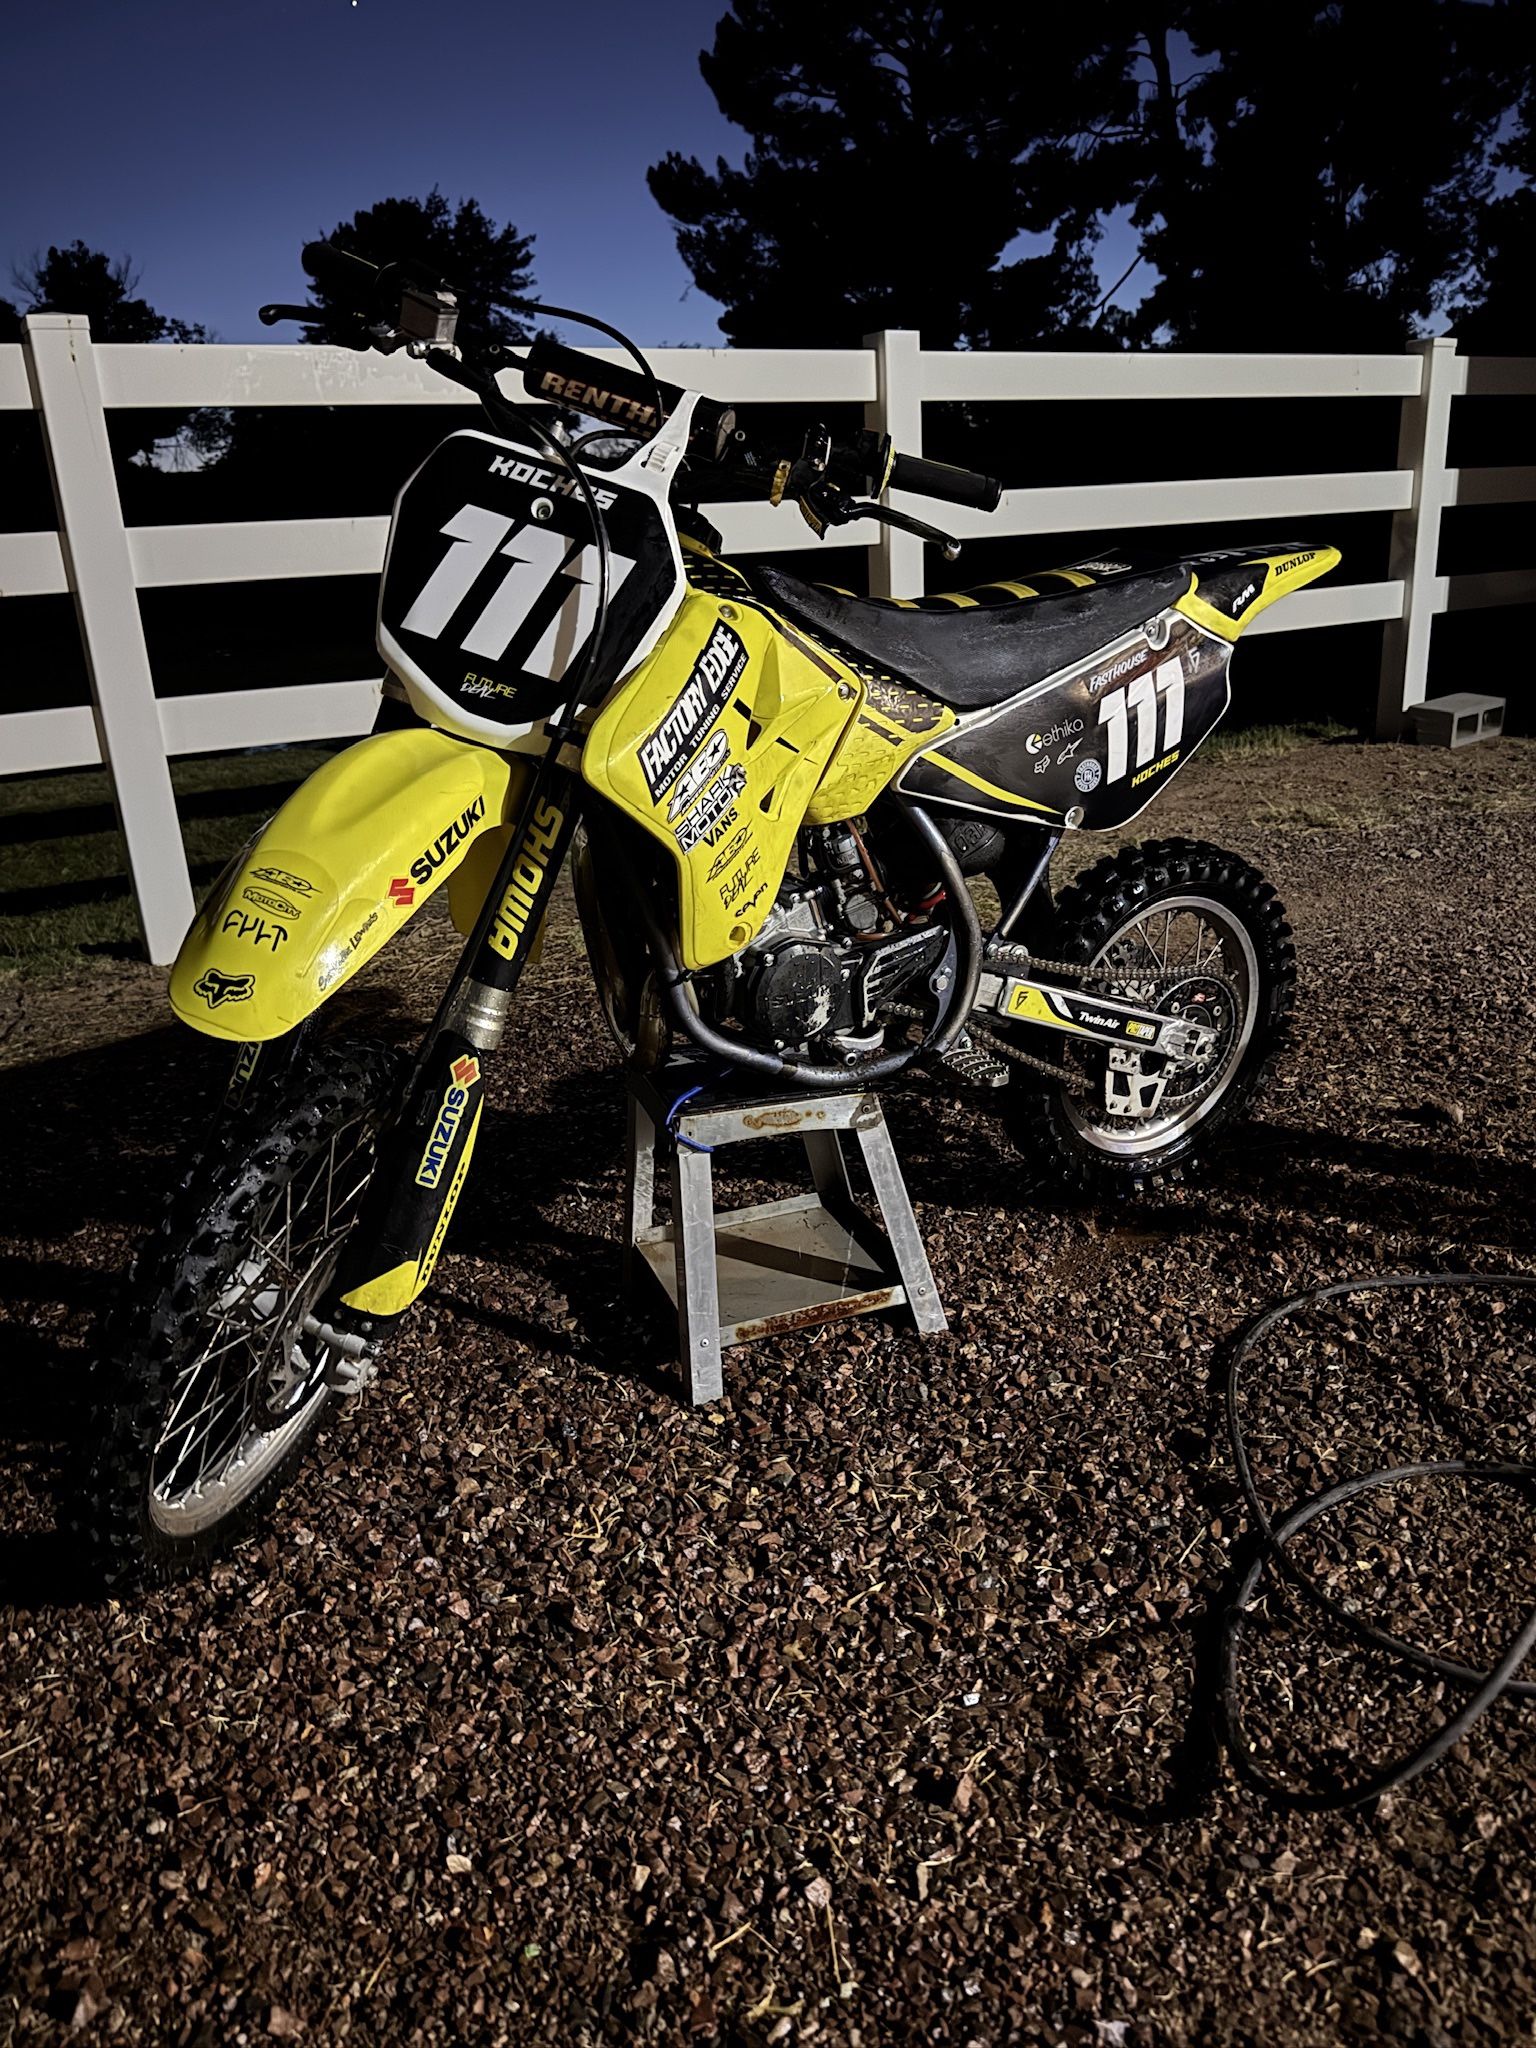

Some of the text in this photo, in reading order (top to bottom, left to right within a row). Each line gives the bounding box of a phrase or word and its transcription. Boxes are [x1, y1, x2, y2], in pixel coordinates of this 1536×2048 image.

[540, 371, 658, 428] RENTH
[400, 503, 637, 682] 111
[1274, 552, 1316, 576] DUNLOP
[1232, 584, 1255, 613] RM
[463, 672, 517, 699] FUTURE
[1089, 649, 1149, 693] FASTHOUSE
[640, 672, 708, 785] FACTORY
[699, 625, 740, 694] EDGE
[654, 753, 689, 798] MOTOR
[689, 703, 721, 748] TUNING
[721, 652, 747, 700] SERVICE
[1042, 718, 1084, 747] ethika
[1098, 655, 1185, 785] 111
[1131, 750, 1180, 788] KOCHES
[410, 794, 486, 885] SUZUKI
[703, 807, 738, 847] VANS
[487, 795, 564, 961] SHOWA
[418, 1088, 466, 1185] SUZUKI
